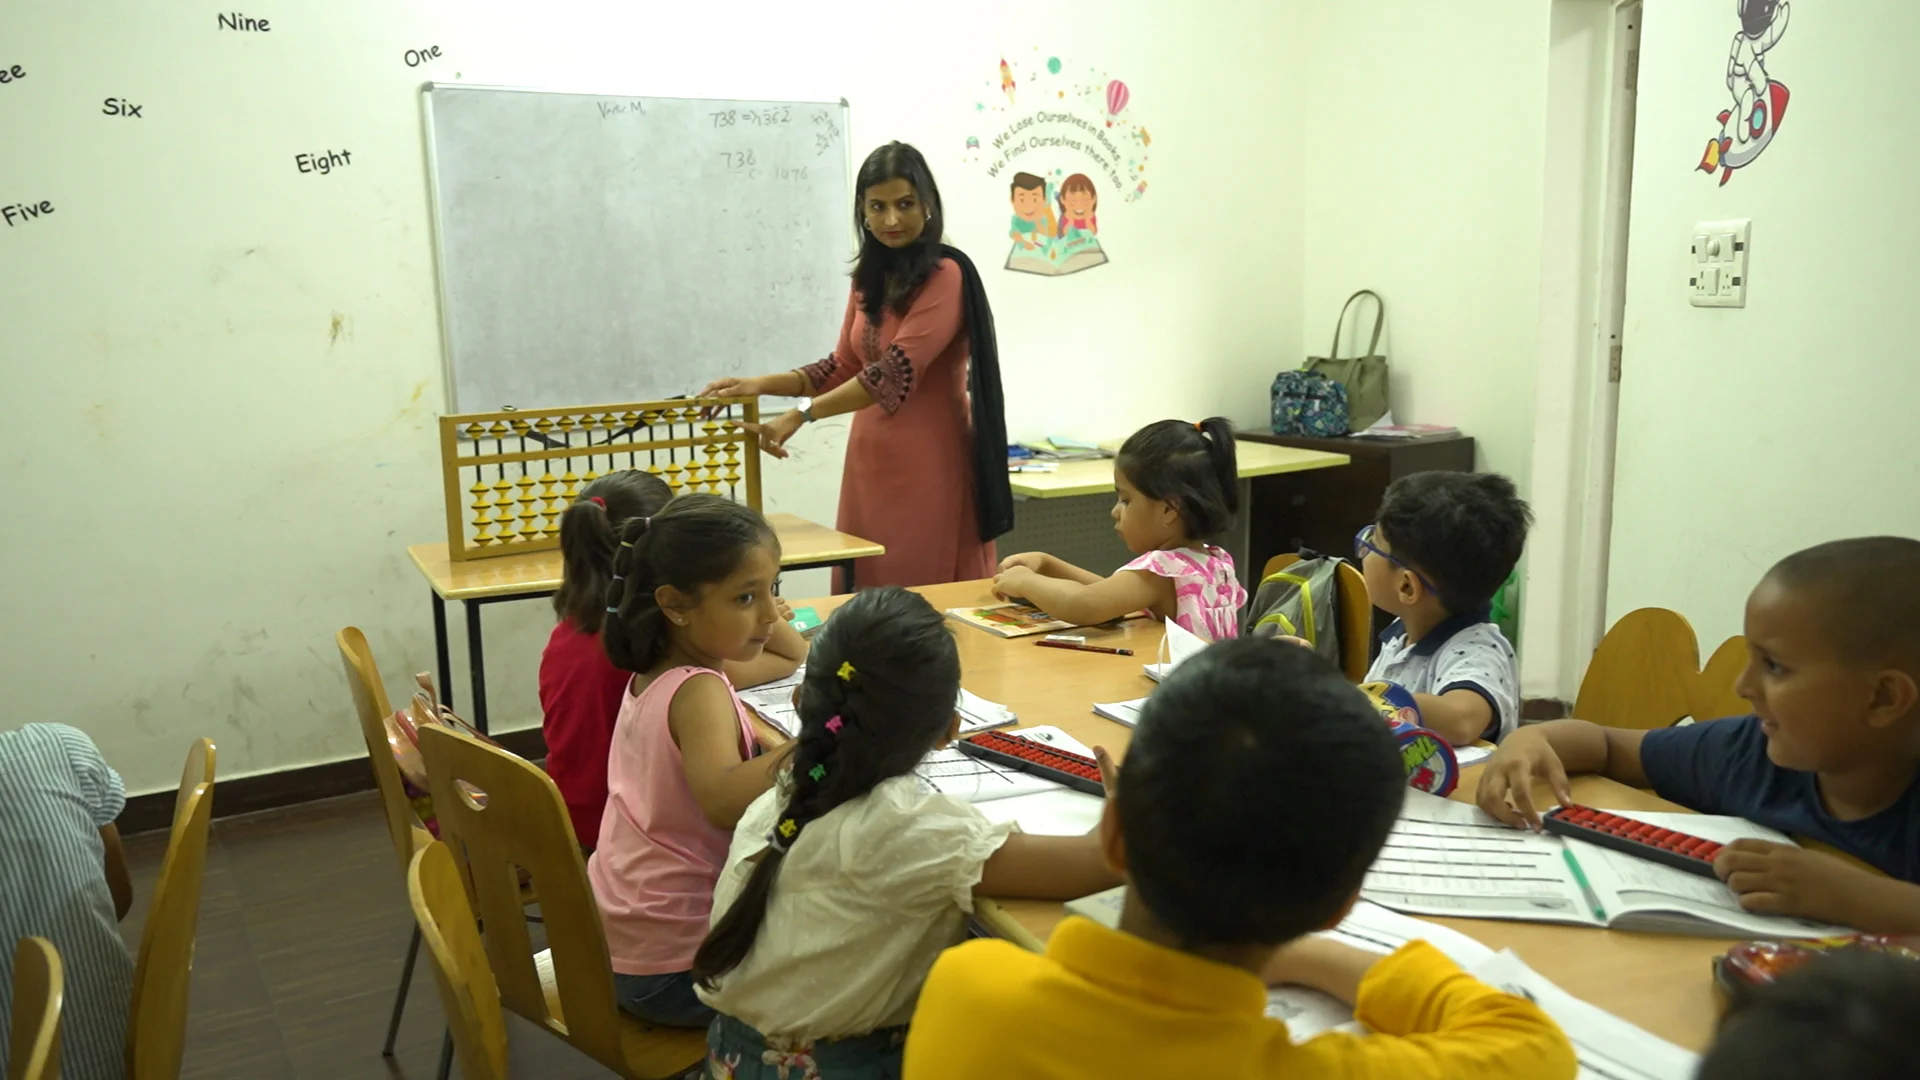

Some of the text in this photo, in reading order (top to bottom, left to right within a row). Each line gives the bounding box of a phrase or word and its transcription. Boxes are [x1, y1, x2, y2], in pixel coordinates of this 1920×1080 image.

[218, 12, 271, 32] Nine
[404, 44, 442, 67] One
[102, 98, 143, 118] Six
[992, 132, 1010, 149] We
[1009, 116, 1034, 135] Lose
[1036, 111, 1088, 130] Ourselves
[1087, 122, 1097, 136] in
[295, 148, 352, 175] Eight
[987, 160, 1005, 178] We
[1003, 140, 1027, 162] Find
[1029, 134, 1081, 150] Ourselves
[1084, 144, 1110, 171] there
[1, 200, 55, 227] Five
